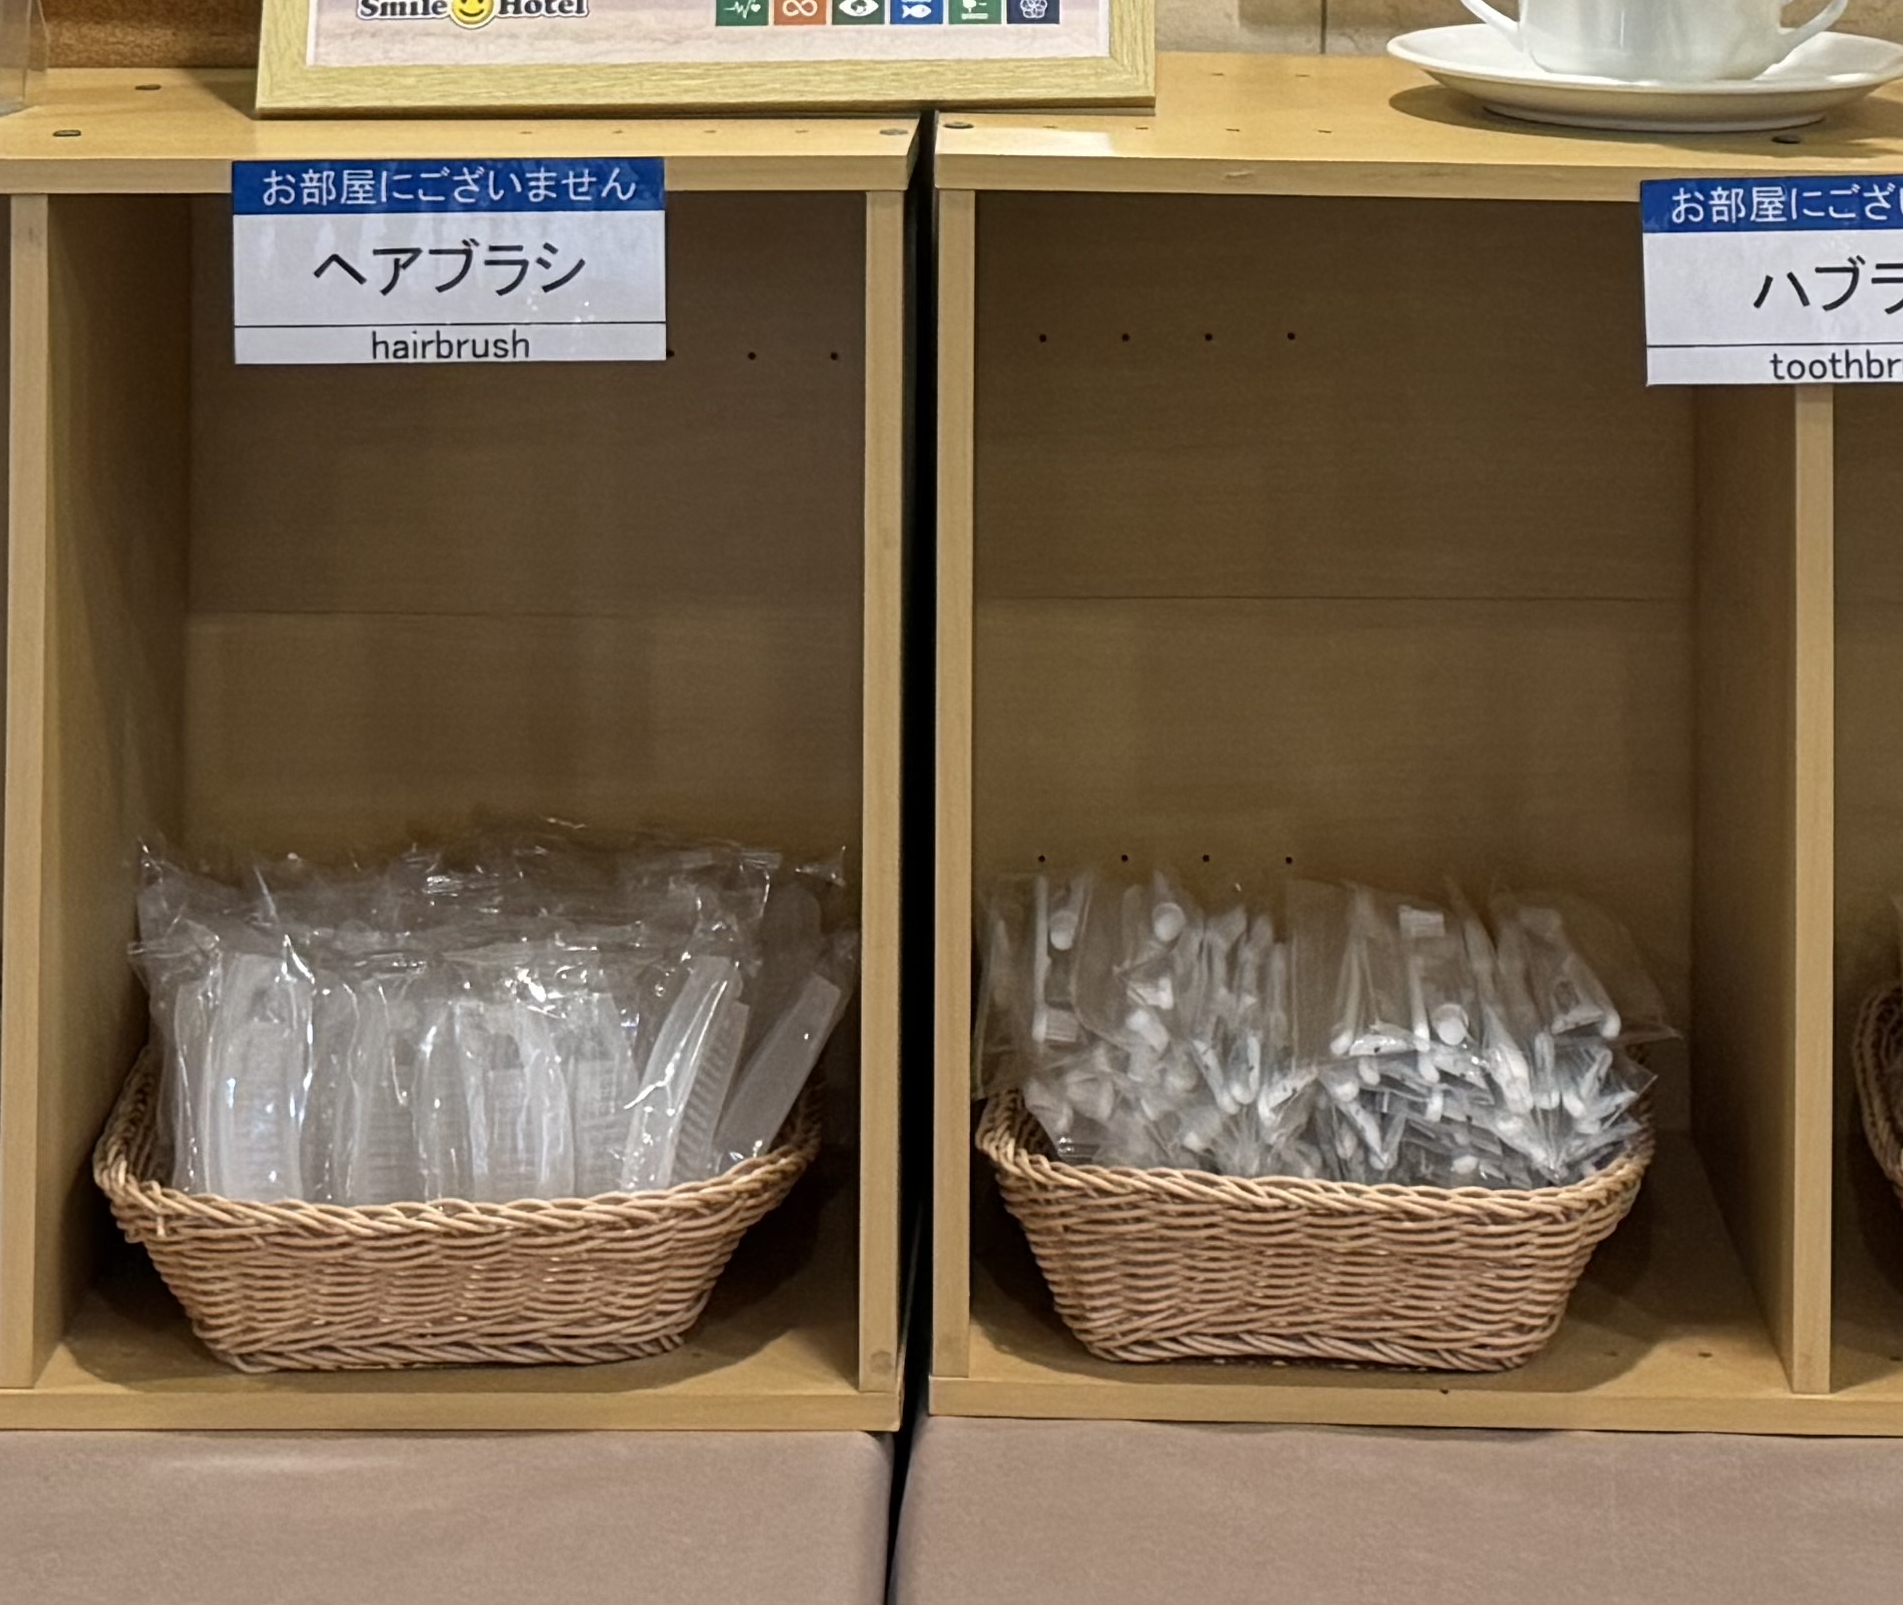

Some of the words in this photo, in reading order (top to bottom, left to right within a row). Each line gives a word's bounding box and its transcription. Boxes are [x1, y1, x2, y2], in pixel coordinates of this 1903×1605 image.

[262, 167, 636, 205] お部屋にございません
[313, 237, 586, 295] ヘアブラシ
[371, 329, 530, 359] hairbrush
